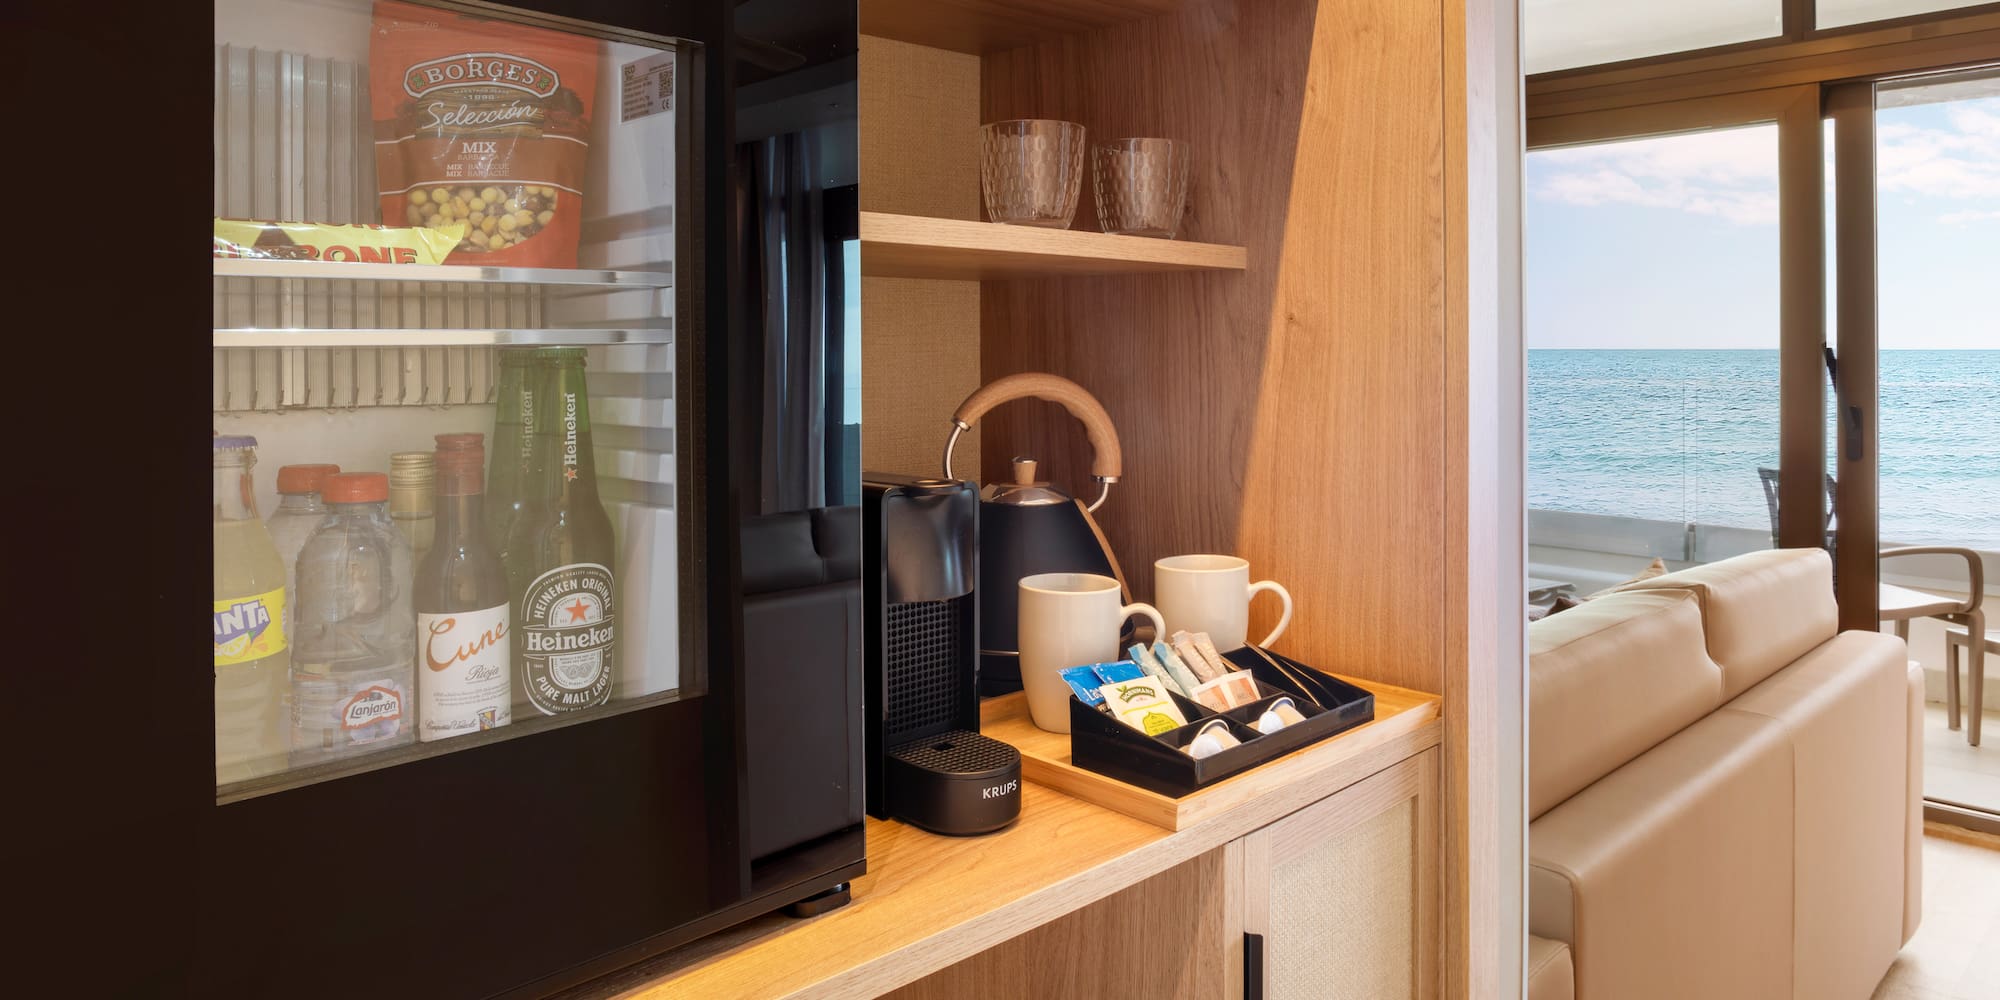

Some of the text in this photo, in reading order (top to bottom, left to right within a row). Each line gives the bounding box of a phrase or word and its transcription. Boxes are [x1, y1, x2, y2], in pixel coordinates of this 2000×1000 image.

[424, 61, 538, 85] BORGES
[423, 100, 538, 129] Selección
[462, 142, 496, 153] MIX
[564, 393, 577, 465] Heineken
[534, 579, 578, 619] HEINEKEN
[582, 578, 612, 611] ORIGINAL
[426, 618, 510, 672] Cune
[527, 626, 614, 650] Heineken
[465, 664, 500, 681] Rioja
[536, 676, 561, 701] PURE
[562, 691, 590, 704] MALT
[592, 666, 610, 696] LAGER
[350, 701, 397, 719] Lanjarón
[983, 779, 1017, 799] KRUPS
